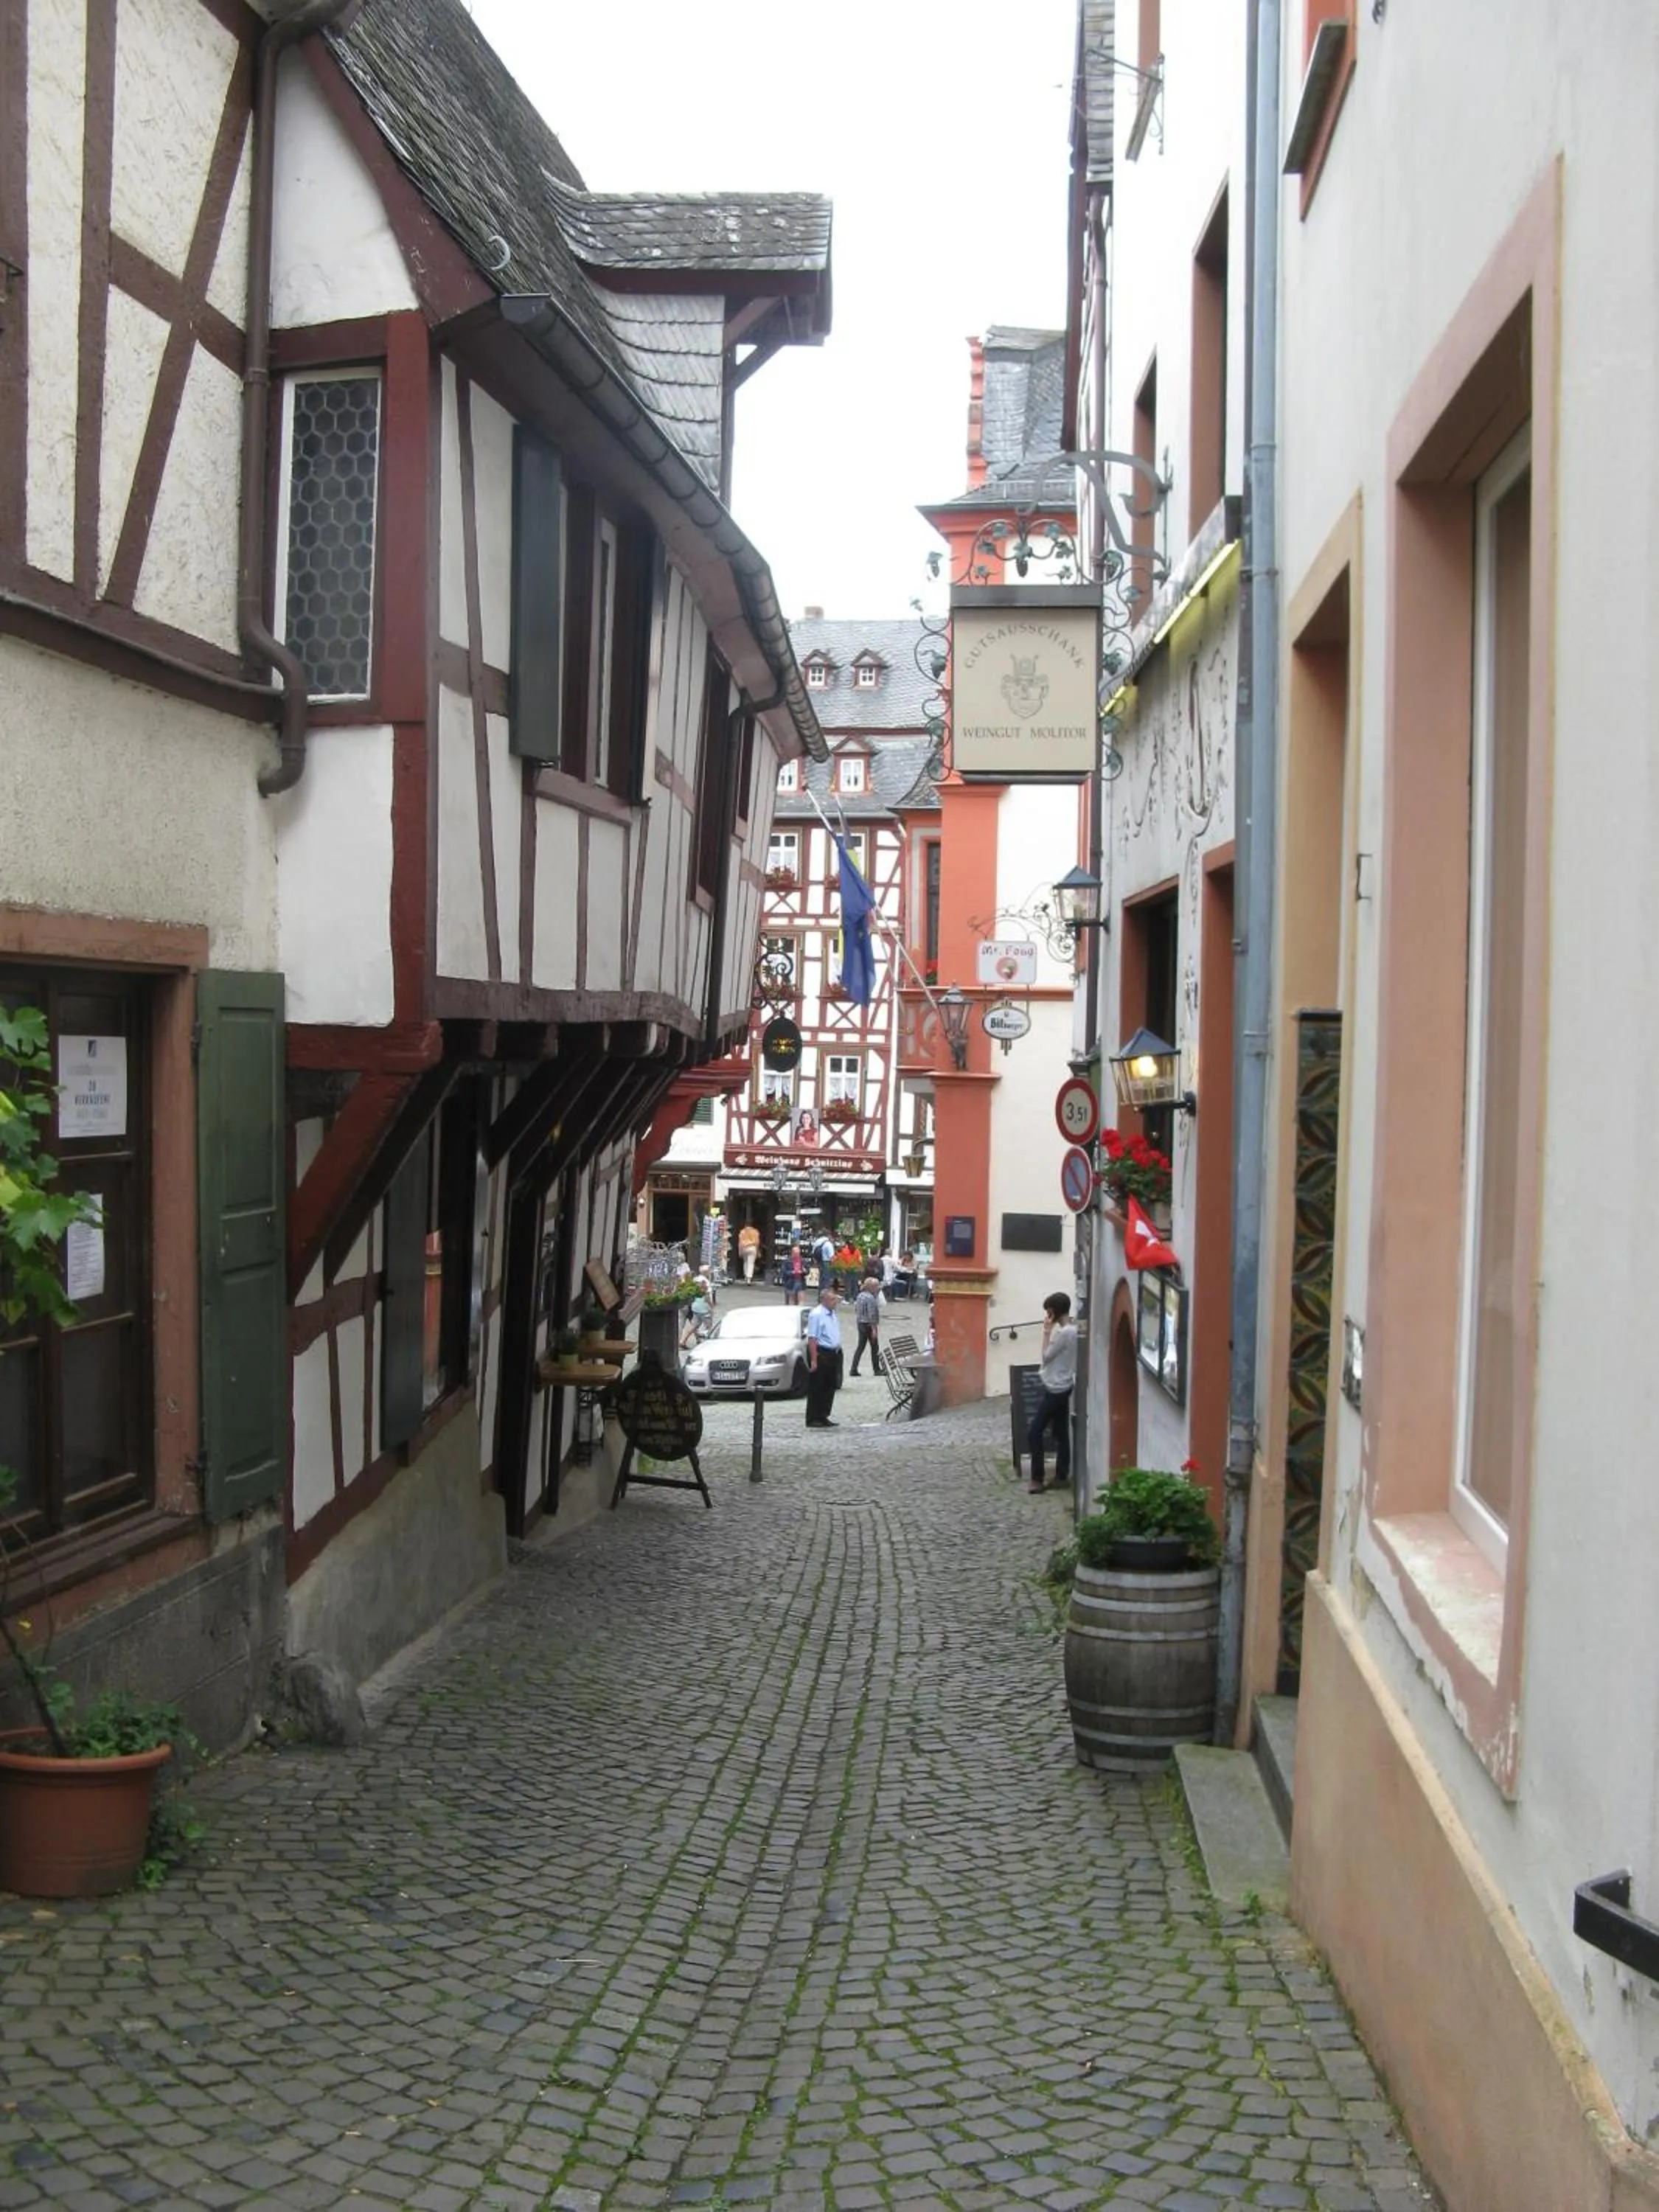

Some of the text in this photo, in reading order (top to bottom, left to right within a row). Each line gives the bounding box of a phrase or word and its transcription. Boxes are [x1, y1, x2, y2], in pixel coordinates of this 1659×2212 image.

[964, 622, 1086, 669] GUTSAUSSCHANK
[962, 726, 1087, 738] WEINGUT MOLITOR
[981, 945, 1001, 956] Mr.
